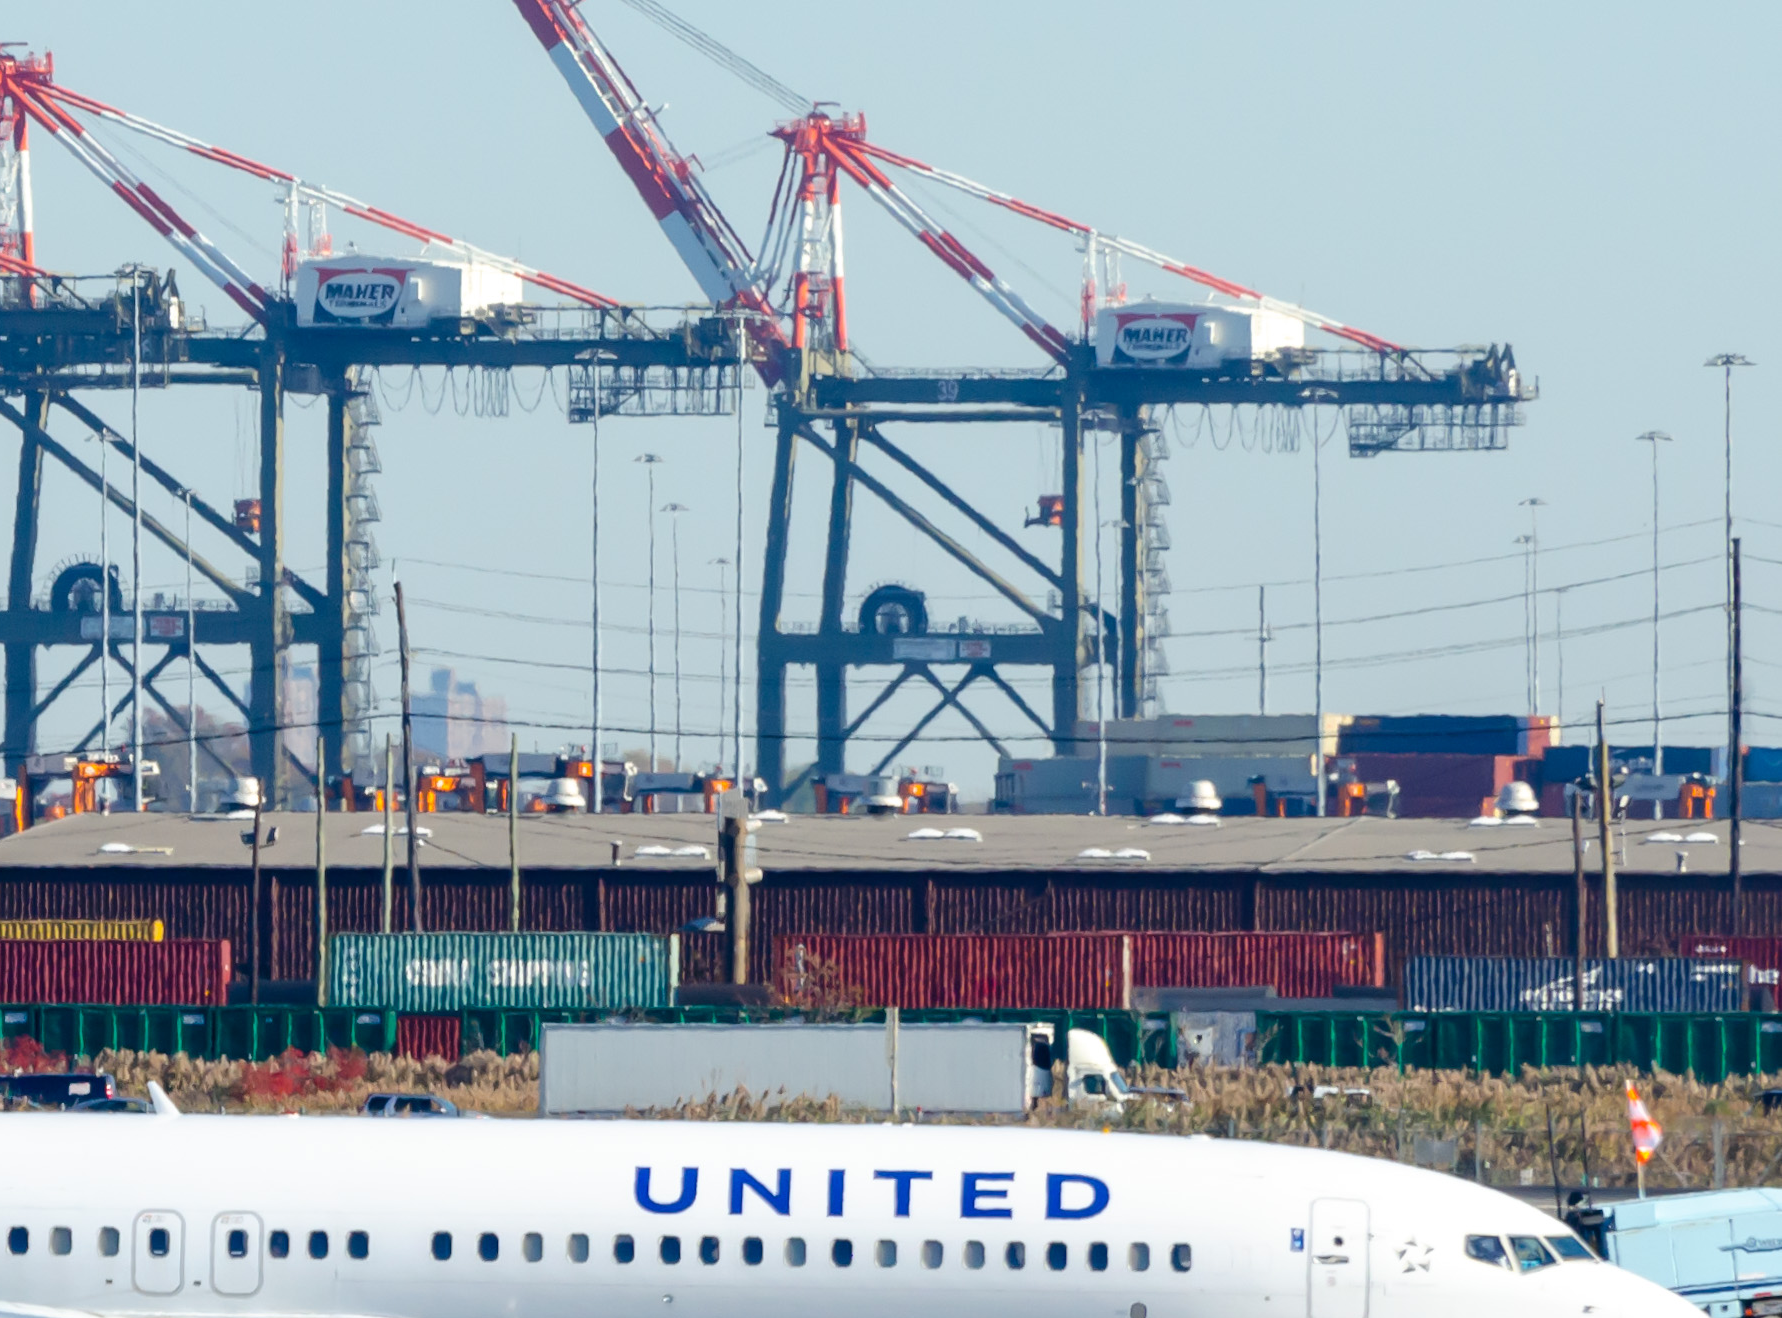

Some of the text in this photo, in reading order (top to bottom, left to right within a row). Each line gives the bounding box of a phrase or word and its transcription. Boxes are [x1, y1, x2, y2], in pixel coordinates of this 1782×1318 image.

[324, 283, 396, 299] MAHER
[1122, 327, 1188, 343] MAHER
[937, 380, 959, 401] 39
[633, 1166, 1111, 1220] UNITED
